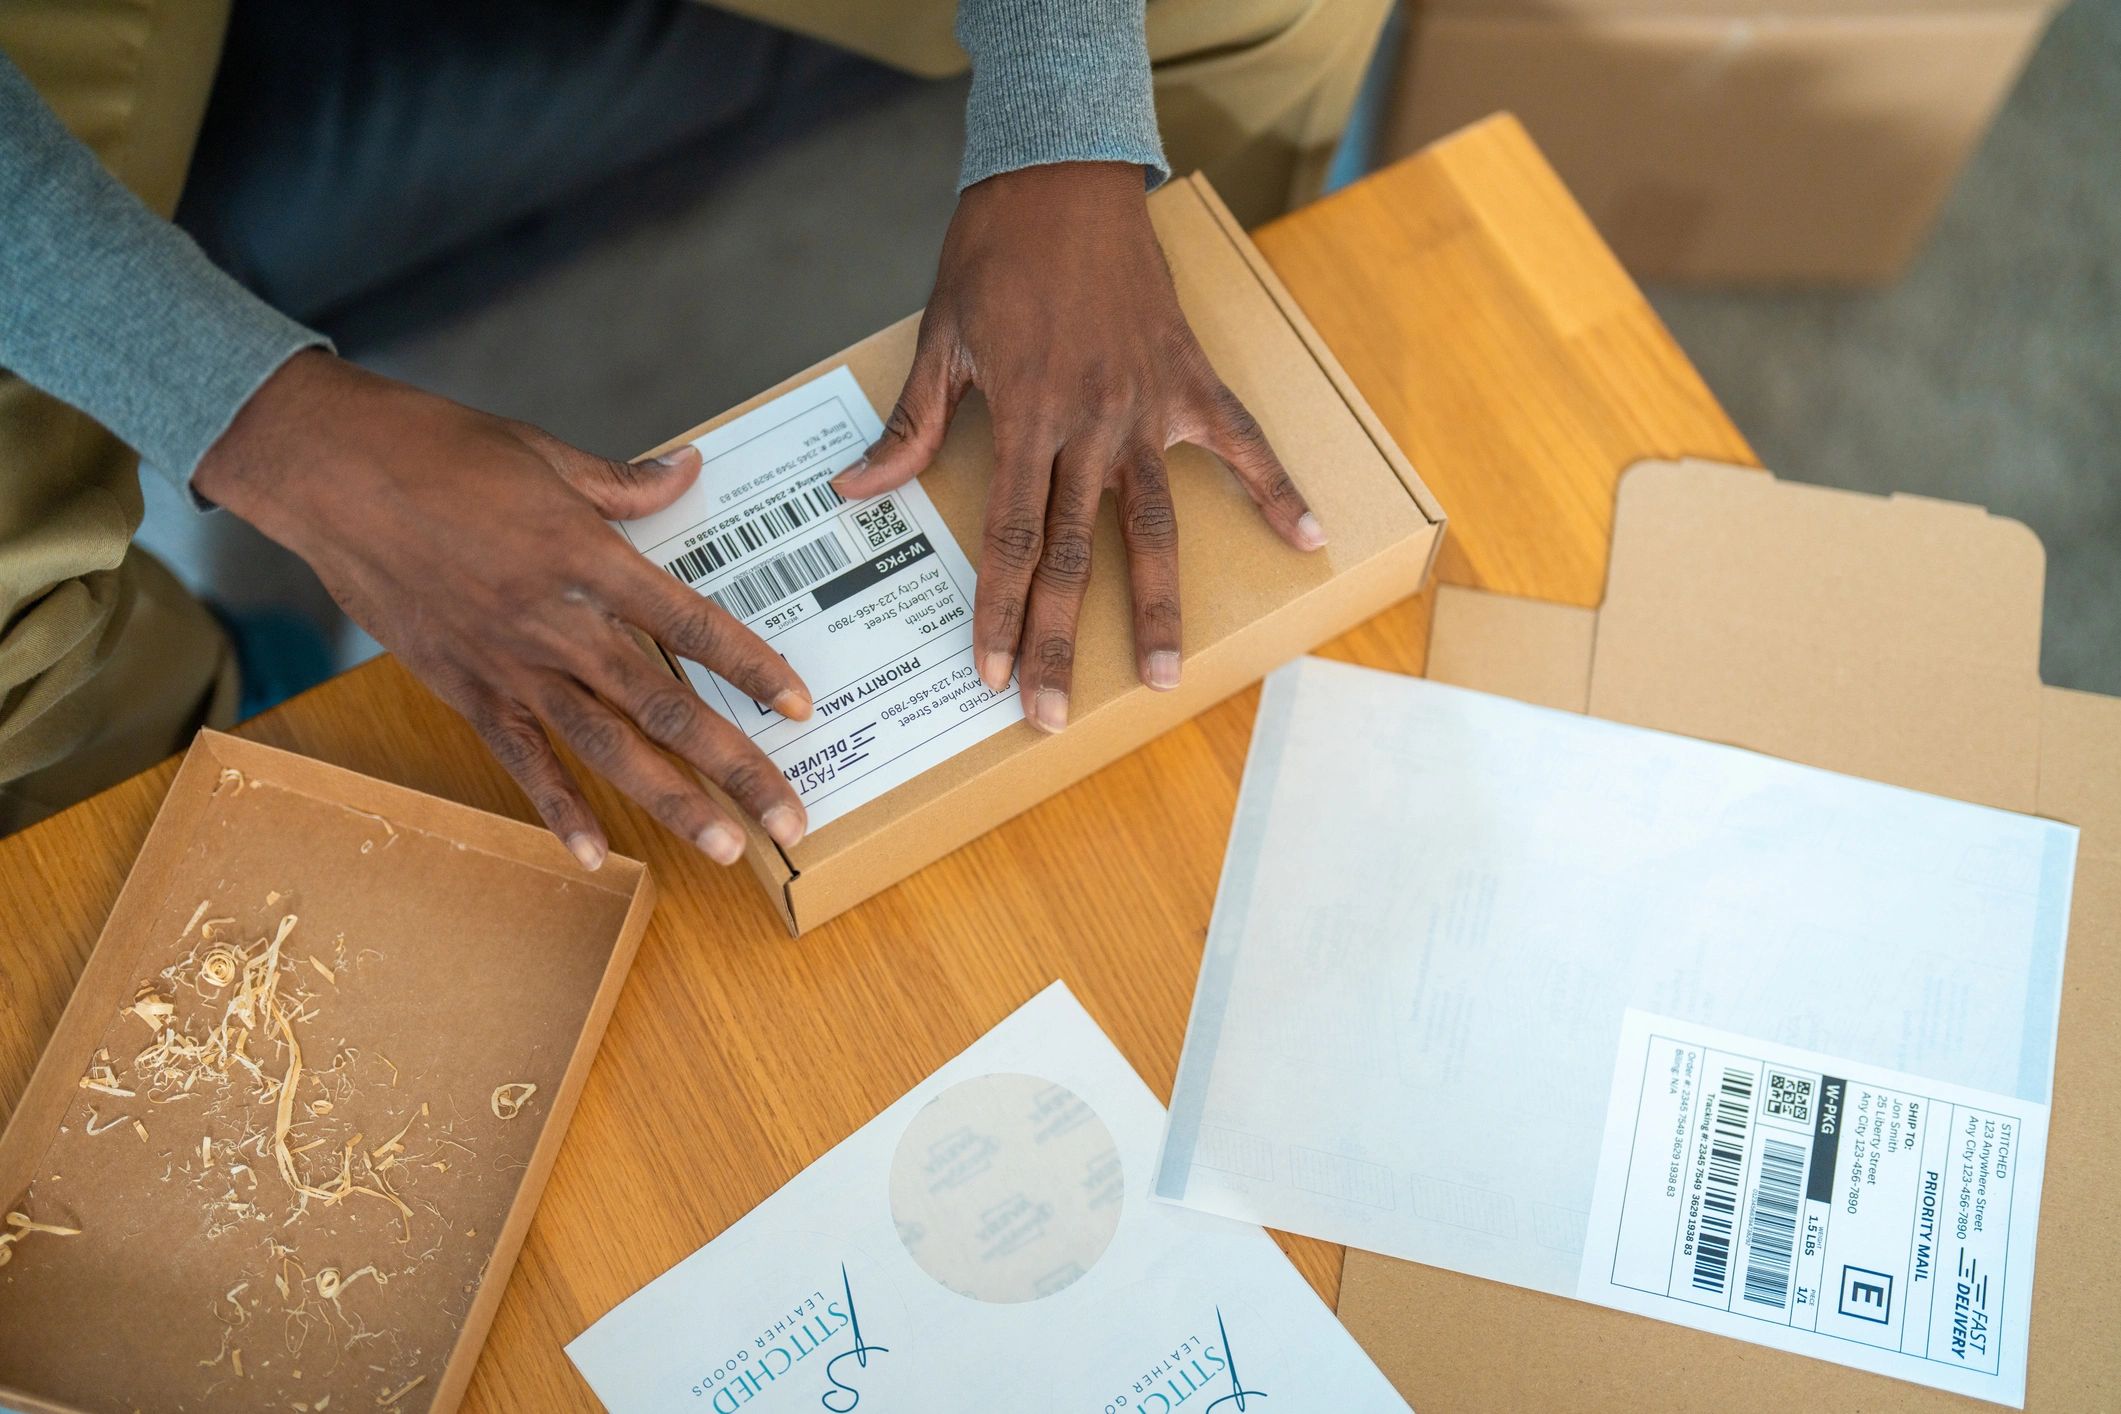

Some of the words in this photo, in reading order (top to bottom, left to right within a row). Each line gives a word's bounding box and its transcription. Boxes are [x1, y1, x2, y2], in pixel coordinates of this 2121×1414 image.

[774, 459, 797, 474] 7549
[795, 447, 818, 464] 2345
[730, 481, 753, 497] 1938
[752, 470, 775, 486] 3629
[794, 466, 834, 489] Tracking
[718, 492, 731, 504] 83
[742, 501, 765, 517] 7549
[763, 489, 787, 506] 2345
[717, 513, 741, 530] 3629
[683, 536, 696, 548] 83
[695, 525, 718, 542] 1938
[874, 541, 925, 573] W-PKG
[919, 567, 939, 583] Any
[897, 579, 919, 595] City
[933, 580, 949, 594] 25
[785, 602, 803, 617] 1.5
[897, 587, 934, 612] Liberty
[934, 592, 954, 608] Jon
[763, 611, 786, 628] LBS
[777, 615, 798, 630] WEIGHT
[826, 590, 897, 633] 123-456-7890
[863, 607, 897, 630] Street
[903, 604, 936, 625] Smith
[938, 605, 964, 625] SHIP
[917, 620, 939, 634] TO:
[856, 656, 921, 699] PRIORITY
[950, 665, 973, 681] City
[815, 691, 855, 716] MAIL
[879, 676, 951, 720] 123-456-7890
[930, 676, 982, 708] Anywhere
[897, 704, 932, 727] Street
[799, 762, 835, 795] FAST
[1684, 1051, 1696, 1078] Order
[1668, 1077, 1679, 1094] N/A
[1678, 1088, 1690, 1112] 2345
[1820, 1084, 1840, 1134] W-PKG
[1856, 1091, 1871, 1113] Any
[1876, 1094, 1888, 1109] 25
[1891, 1097, 1903, 1119] Jon
[1699, 1093, 1715, 1131] Tracking
[1906, 1102, 1919, 1130] SHIP
[1675, 1113, 1687, 1136] 7549
[1853, 1114, 1868, 1137] City
[1868, 1110, 1885, 1149] Liberty
[1964, 1115, 1979, 1138] Any
[1983, 1119, 1995, 1139] 123
[1671, 1136, 1683, 1160] 3629
[1887, 1121, 1900, 1153] Smith
[1903, 1132, 1915, 1150] TO:
[1696, 1142, 1707, 1166] 2345
[1961, 1138, 1976, 1162] City
[1995, 1122, 2011, 1179] STITCHED
[1667, 1161, 1679, 1184] 1938
[1692, 1167, 1704, 1190] 7549
[1846, 1138, 1865, 1215] 123-456-7890
[1866, 1150, 1880, 1185] Street
[1976, 1140, 1992, 1196] Anywhere
[1665, 1184, 1676, 1198] 83
[1955, 1163, 1973, 1240] 123-456-7890
[1688, 1193, 1700, 1218] 3629
[1918, 1170, 1938, 1242] PRIORITY
[1972, 1197, 1986, 1232] Street
[1684, 1218, 1696, 1242] 1938
[1806, 1214, 1818, 1232] 1.5
[1682, 1242, 1693, 1256] 83
[1803, 1233, 1816, 1256] LBS
[1815, 1226, 1824, 1249] WEIGHT
[1913, 1243, 1930, 1282] MAIL
[1795, 1286, 1808, 1304] 1/1
[1808, 1288, 1816, 1306] PIECE
[1850, 1280, 1884, 1308] E
[753, 1291, 824, 1348] LEATHER
[1950, 1281, 1970, 1359] DELIVERY
[1968, 1309, 1988, 1355] FAST
[711, 1301, 848, 1414] STITCHED
[1131, 1334, 1200, 1393] LEATHER
[690, 1349, 748, 1397] GOODS
